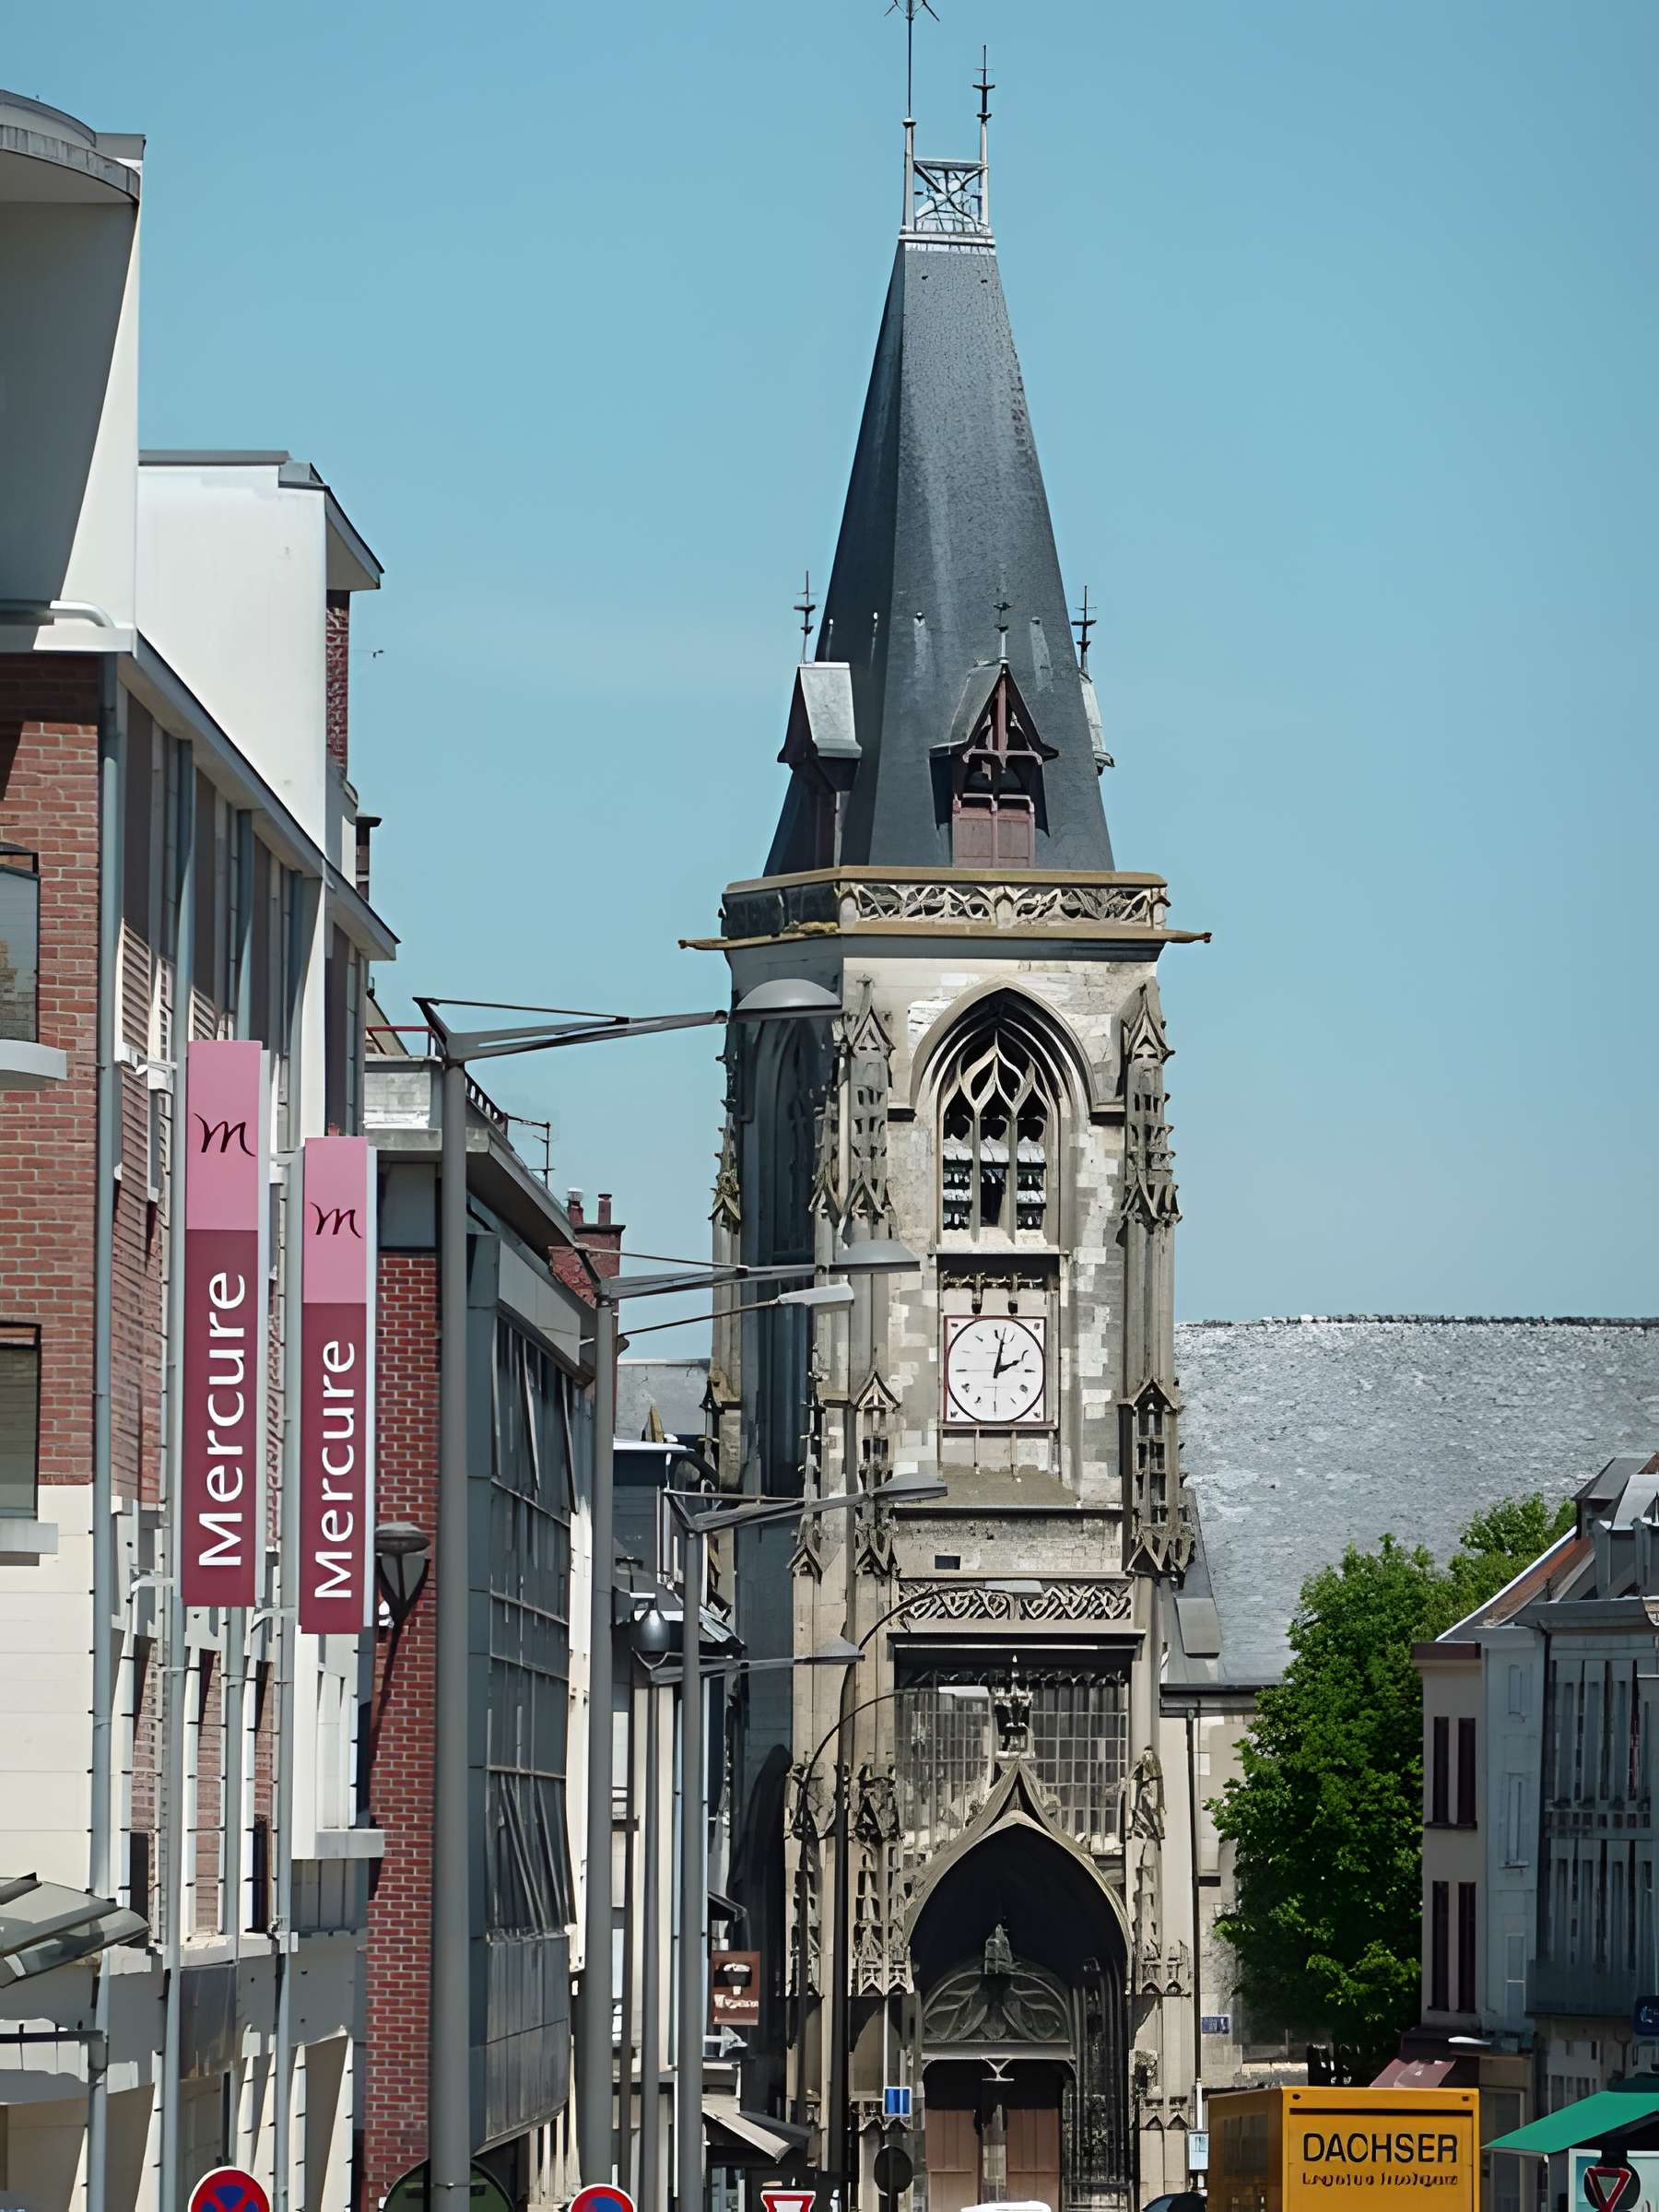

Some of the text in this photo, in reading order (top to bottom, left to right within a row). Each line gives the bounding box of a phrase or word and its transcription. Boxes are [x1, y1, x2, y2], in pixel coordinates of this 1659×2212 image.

[198, 1272, 246, 1567] Mercure
[313, 1339, 356, 1599] Mercure
[1303, 2132, 1458, 2163] DACHSER
